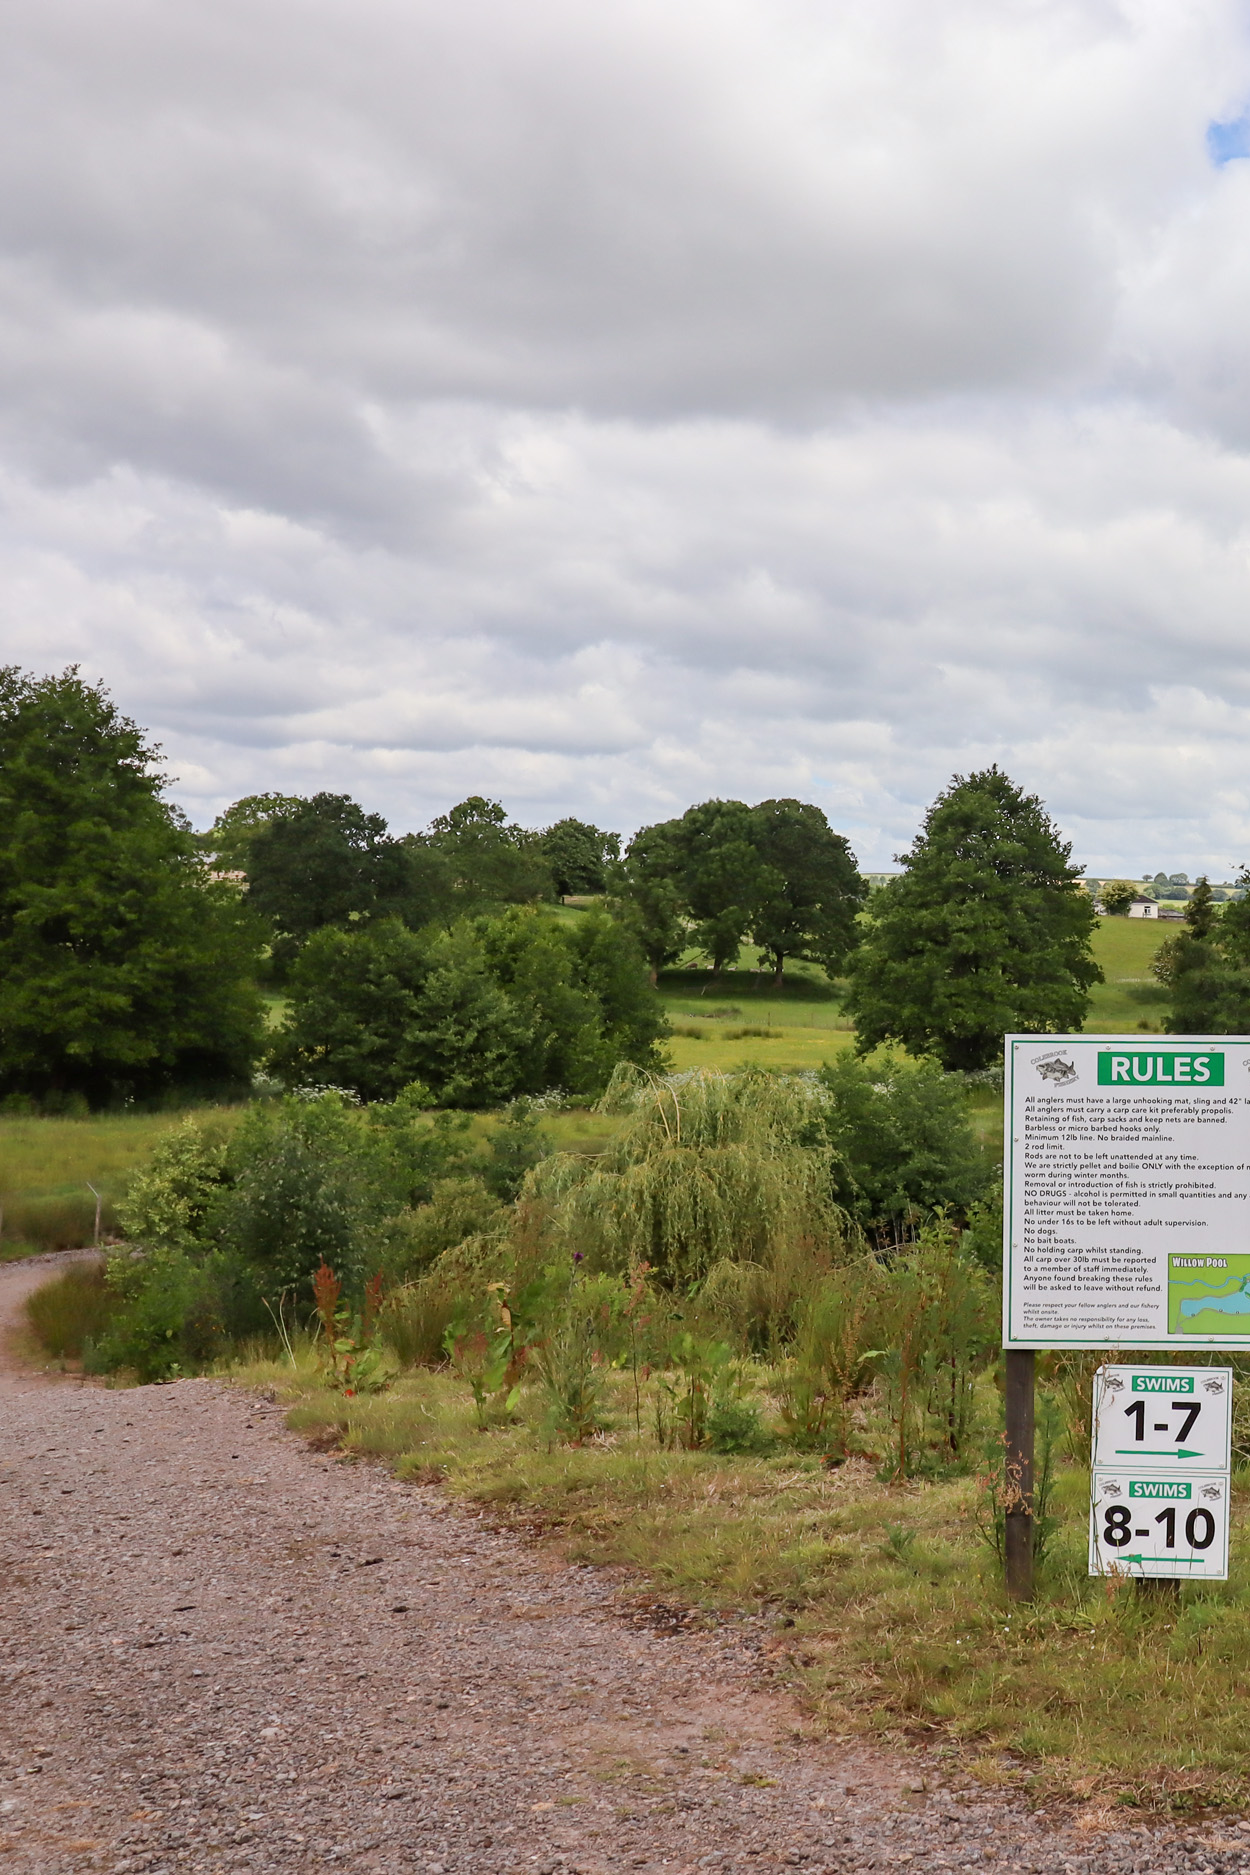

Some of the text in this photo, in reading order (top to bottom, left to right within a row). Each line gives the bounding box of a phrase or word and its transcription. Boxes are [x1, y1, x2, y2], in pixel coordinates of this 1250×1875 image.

[1112, 1057, 1211, 1081] RULES
[1037, 1096, 1064, 1105] anglers
[1066, 1097, 1084, 1105] must
[1086, 1096, 1104, 1104] have
[1112, 1096, 1131, 1106] large
[1133, 1097, 1172, 1106] unhooking
[1193, 1097, 1210, 1107] sling
[1212, 1097, 1227, 1105] and
[1025, 1105, 1035, 1113] All
[1037, 1105, 1064, 1115] anglers
[1086, 1107, 1105, 1115] carry
[1113, 1107, 1129, 1115] carp
[1149, 1106, 1159, 1114] kit
[1161, 1106, 1199, 1116] preferably
[1201, 1107, 1233, 1116] propolis.
[1025, 1114, 1060, 1124] Retaining
[1061, 1114, 1070, 1123] of
[1072, 1114, 1087, 1123] fish,
[1107, 1115, 1127, 1123] sacks
[1128, 1115, 1143, 1123] and
[1144, 1115, 1164, 1125] keep
[1197, 1116, 1227, 1124] banned.
[1025, 1124, 1056, 1132] Barbless
[1090, 1124, 1118, 1132] barbed
[1119, 1124, 1142, 1133] hooks
[1143, 1125, 1161, 1134] only.
[1024, 1133, 1059, 1141] Minimum
[1061, 1133, 1078, 1141] 12lb
[1097, 1134, 1109, 1142] No
[1110, 1134, 1140, 1142] braided
[1141, 1134, 1175, 1142] mainline.
[1024, 1142, 1030, 1150] 2
[1025, 1152, 1043, 1160] Rods
[1059, 1153, 1071, 1161] not
[1074, 1153, 1082, 1161] to
[1084, 1152, 1093, 1160] be
[1096, 1152, 1108, 1160] left
[1110, 1153, 1153, 1161] unattended
[1165, 1155, 1178, 1163] any
[1180, 1153, 1198, 1161] time.
[1024, 1161, 1037, 1169] We
[1053, 1162, 1078, 1171] strictly
[1080, 1162, 1101, 1171] pellet
[1103, 1162, 1117, 1170] and
[1142, 1162, 1163, 1170] ONLY
[1165, 1162, 1181, 1170] with
[1183, 1162, 1195, 1170] the
[1198, 1163, 1234, 1173] exception
[1236, 1163, 1244, 1171] of
[1047, 1171, 1072, 1180] during
[1074, 1171, 1098, 1179] winter
[1099, 1171, 1129, 1179] months.
[1025, 1180, 1056, 1188] Removal
[1068, 1180, 1113, 1188] introduction
[1115, 1180, 1123, 1189] of
[1140, 1181, 1146, 1189] is
[1148, 1181, 1173, 1191] strictly
[1175, 1181, 1216, 1191] prohibited.
[1024, 1189, 1037, 1197] NO
[1039, 1189, 1067, 1198] DRUGS
[1074, 1189, 1100, 1198] alcohol
[1102, 1190, 1108, 1198] is
[1110, 1190, 1147, 1200] permitted
[1179, 1191, 1216, 1200] quantities
[1218, 1191, 1232, 1199] and
[1234, 1193, 1247, 1201] any
[1024, 1199, 1140, 1208] behaviour will not be tolerated.
[1062, 1218, 1074, 1226] 16s
[1086, 1218, 1096, 1226] be
[1098, 1218, 1111, 1226] left
[1113, 1218, 1141, 1226] without
[1143, 1218, 1162, 1226] adult
[1165, 1219, 1208, 1228] supervision.
[1023, 1227, 1058, 1237] No dogs.
[1024, 1235, 1076, 1244] No bait boats.
[1037, 1246, 1065, 1256] holding
[1085, 1246, 1107, 1254] whilst
[1109, 1246, 1144, 1256] standing.
[1073, 1255, 1090, 1263] 30lb
[1111, 1256, 1121, 1264] be
[1123, 1256, 1157, 1265] reported
[1206, 1257, 1228, 1268] POOL
[1023, 1283, 1036, 1291] will
[1038, 1283, 1048, 1291] be
[1050, 1283, 1072, 1291] asked
[1105, 1284, 1134, 1292] without
[1136, 1284, 1162, 1292] refund.
[1136, 1377, 1189, 1392] SWIMS
[1124, 1401, 1202, 1442] 1-7
[1134, 1483, 1187, 1498] SWIMS
[1103, 1505, 1216, 1550] 8-10
